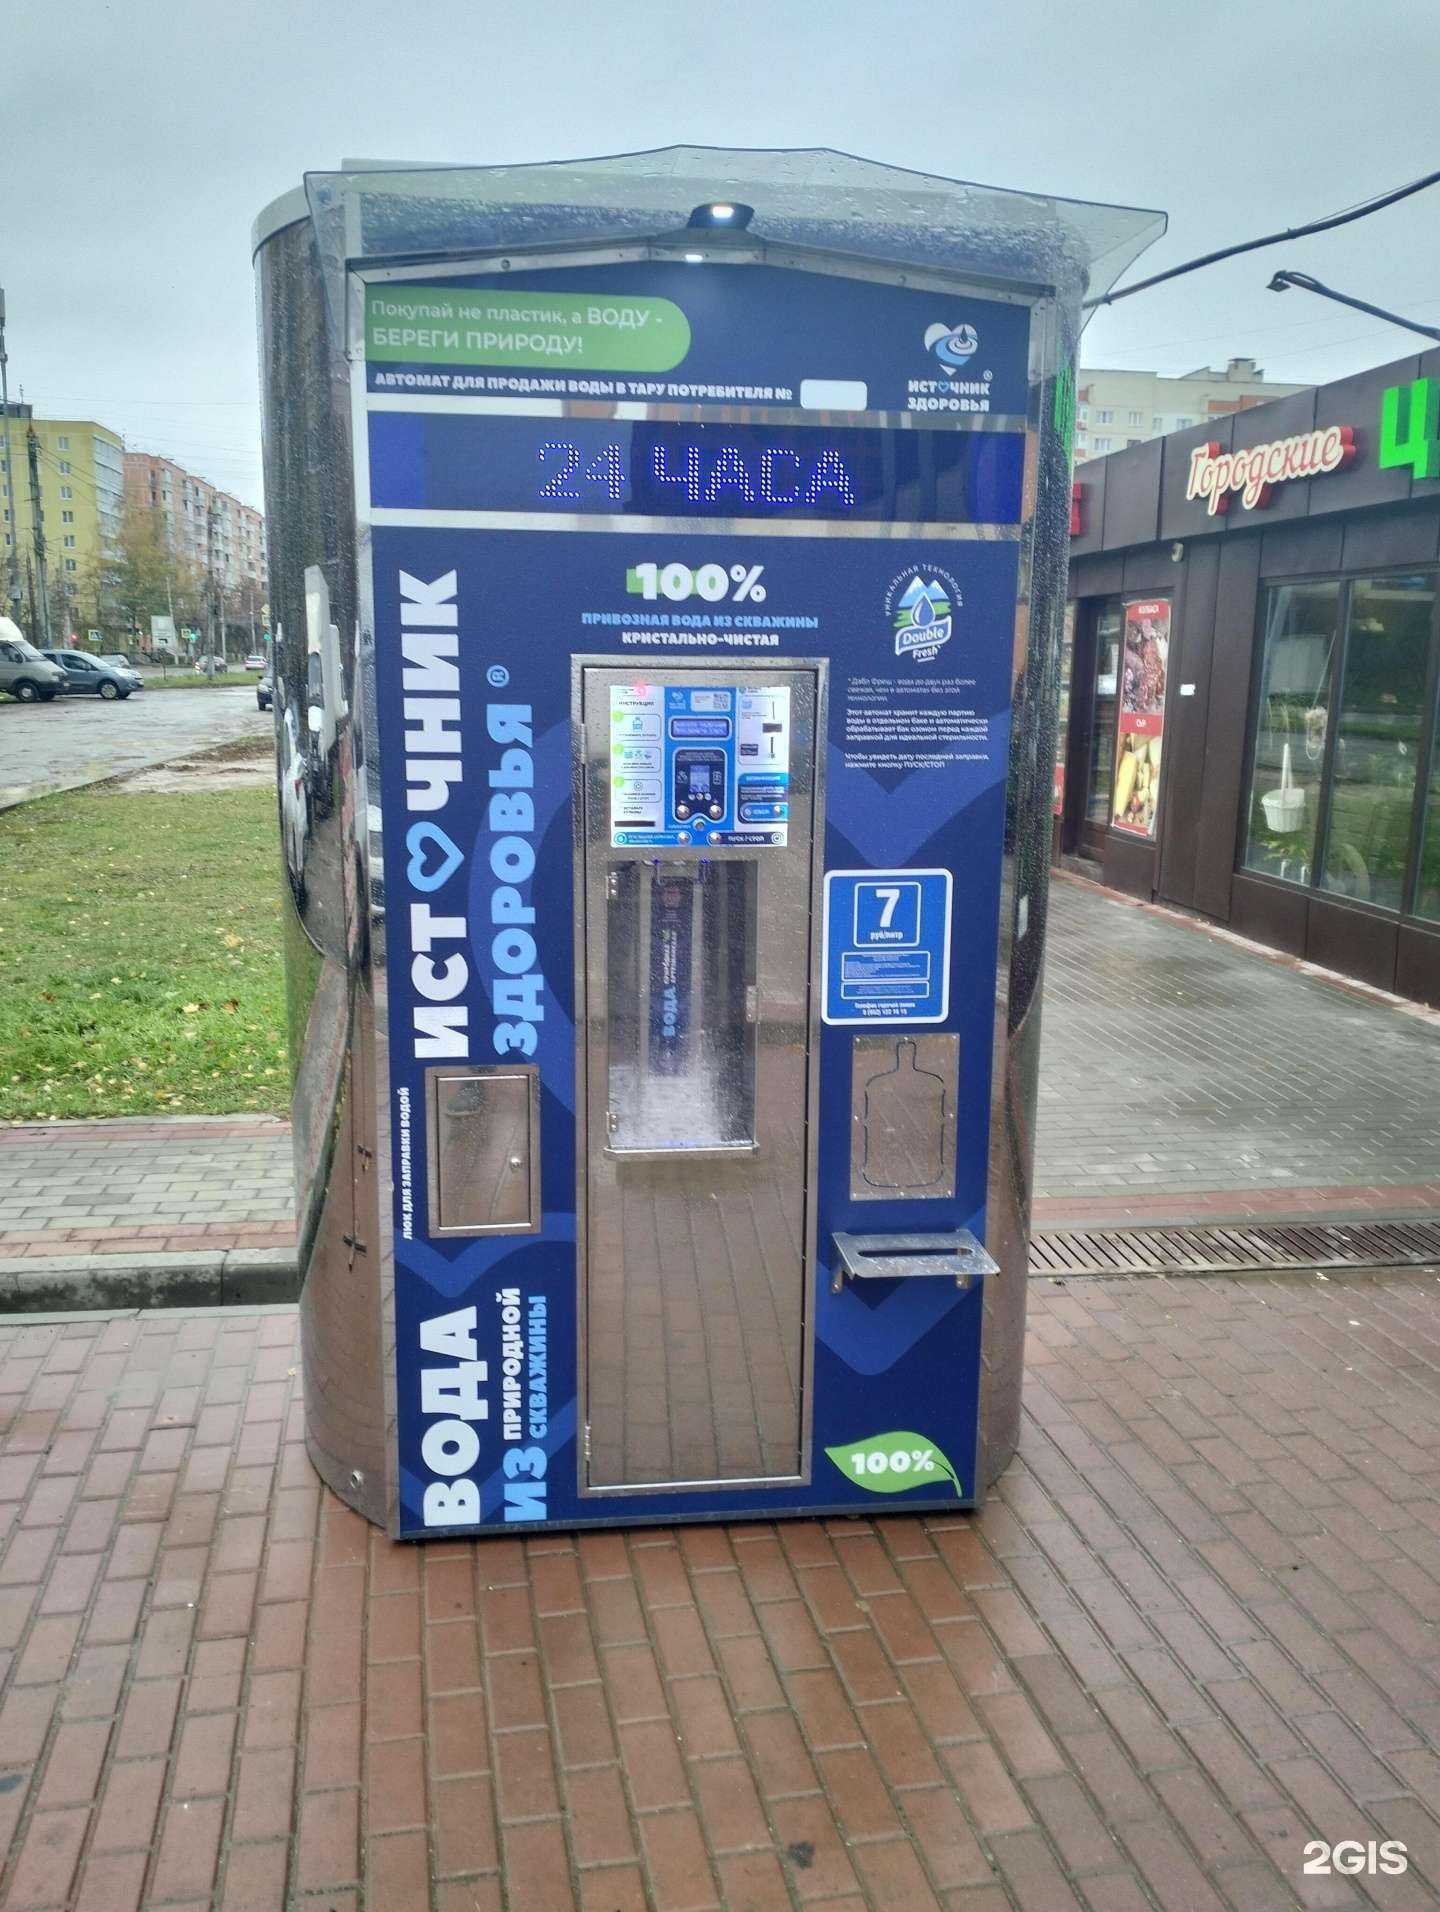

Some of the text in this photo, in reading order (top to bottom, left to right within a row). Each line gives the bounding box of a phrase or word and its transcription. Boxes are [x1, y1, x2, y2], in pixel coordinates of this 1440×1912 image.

[371, 300, 453, 322] Покупай
[459, 308, 481, 320] не
[487, 309, 567, 325] пластик,
[572, 313, 582, 325] а
[587, 308, 650, 329] ВОДУ
[373, 327, 583, 355] БЕРЕГИ ПРИРОДУ!
[375, 372, 793, 400] АВТОМАТ ДЛЯ ПРОДАЖИ ВОДЫ В ТАРУ ПОТРЕБИТЕЛЯ №
[908, 397, 989, 412] ЗДОРОВЬЯ
[538, 441, 855, 504] 24 ЧАСА
[1186, 426, 1345, 516] Городские
[635, 562, 767, 602] 100%
[582, 612, 819, 629] ПРИВОЗНАЯ ВОДА ИЗ СКВАЖИНЫ
[622, 632, 779, 646] КРИСТАЛЬНО-ЧИСТАЯ
[903, 627, 944, 645] Double
[487, 704, 545, 1057] ЗДОРОВЬЯ
[876, 889, 900, 928] 7
[664, 985, 677, 1036] ВОДА
[397, 1087, 413, 1240] ЛЮК ДЛЯ ЗАПРАВКИ ВОДОЙ
[528, 1295, 547, 1438] СКВАЖИНЫ
[419, 1306, 488, 1526] ВОДА
[495, 1288, 547, 1522] ИЗ ПРИРОДНОЙ
[852, 1450, 934, 1475] 100%
